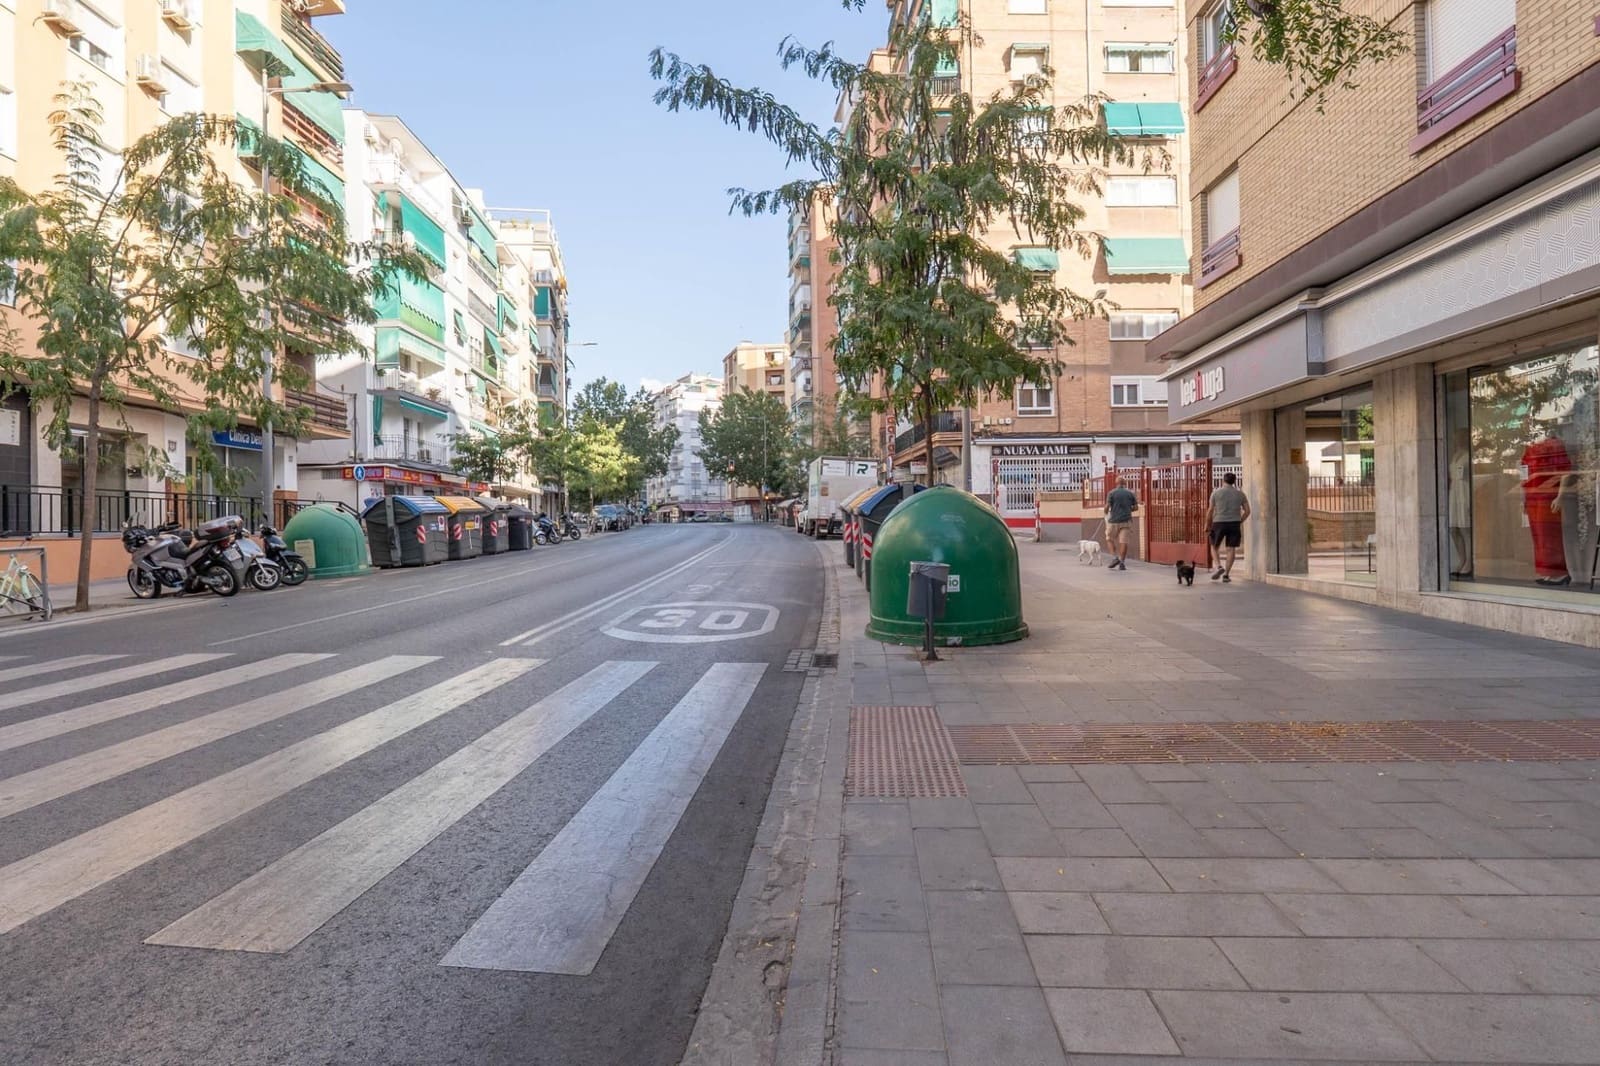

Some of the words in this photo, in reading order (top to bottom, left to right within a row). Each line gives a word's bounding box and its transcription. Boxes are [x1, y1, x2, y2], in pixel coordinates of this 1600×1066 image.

[1180, 366, 1224, 407] lechuga
[1003, 445, 1039, 455] NUEVA
[1041, 445, 1068, 455] JAMI
[639, 608, 750, 630] 30
